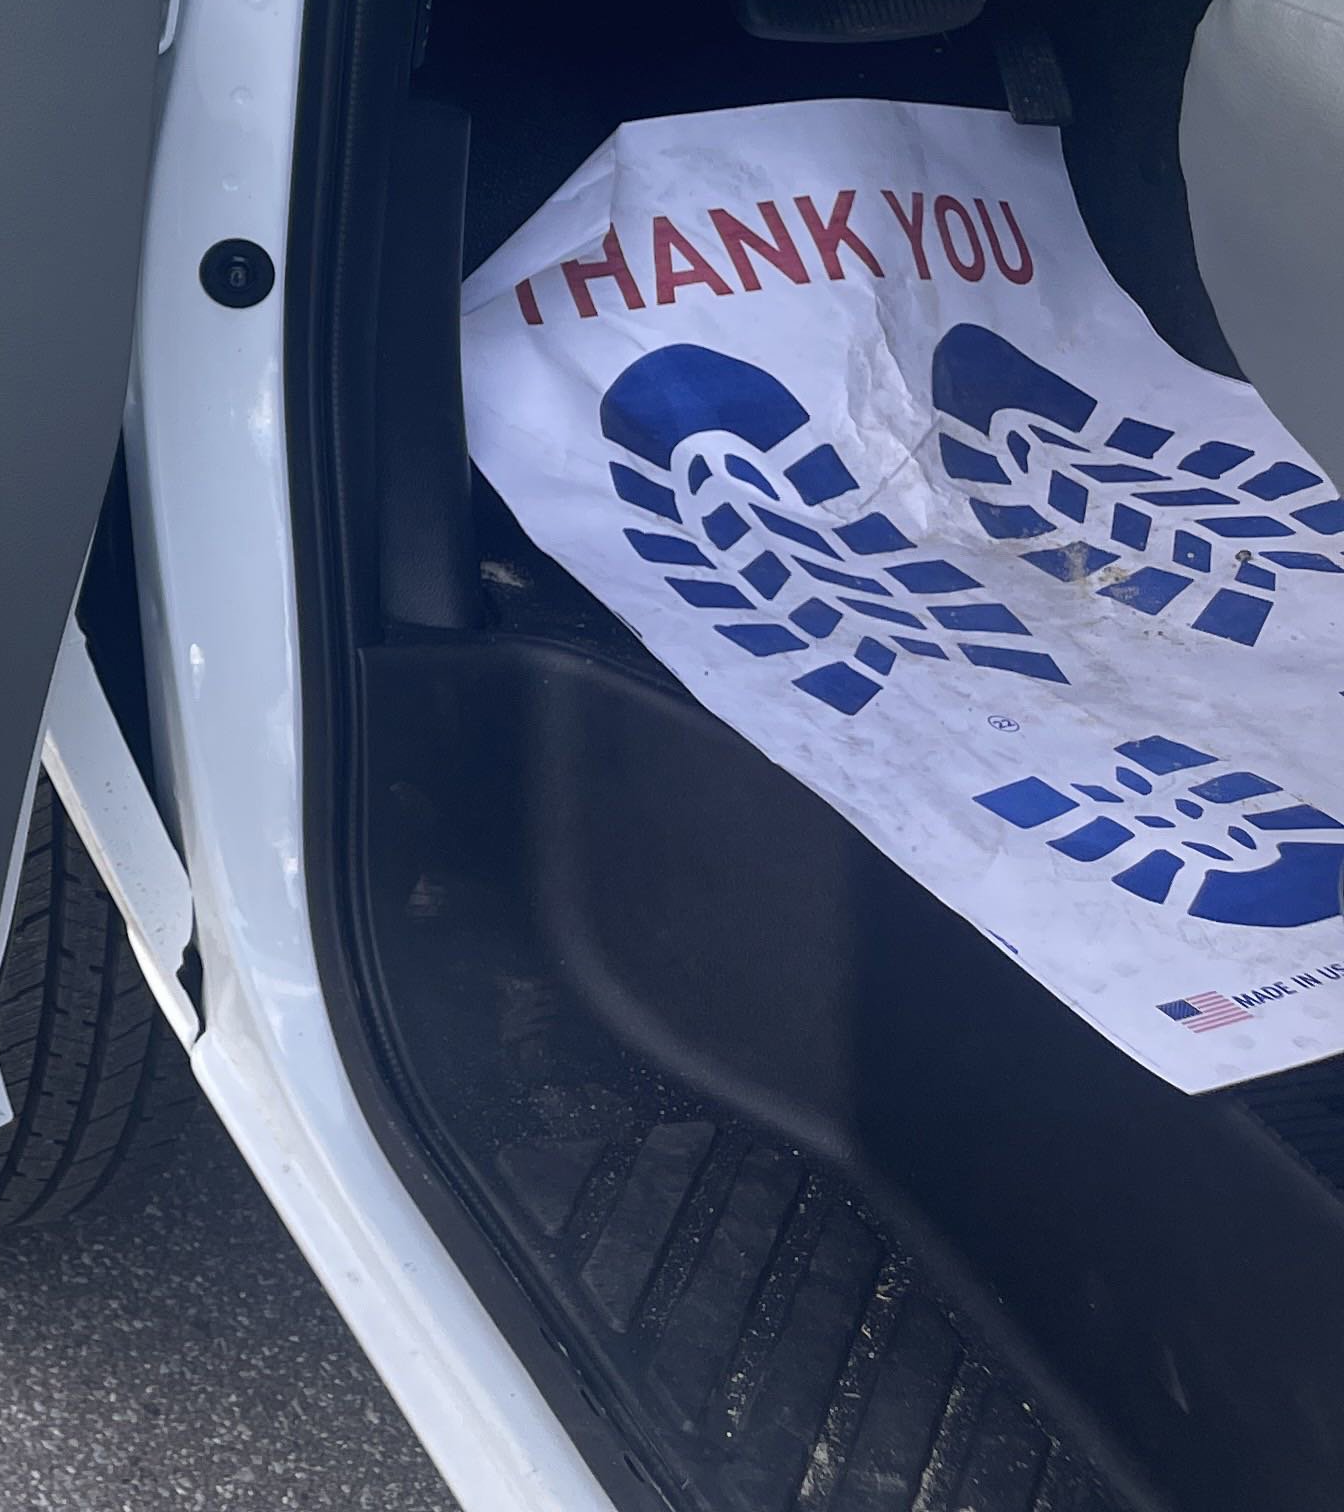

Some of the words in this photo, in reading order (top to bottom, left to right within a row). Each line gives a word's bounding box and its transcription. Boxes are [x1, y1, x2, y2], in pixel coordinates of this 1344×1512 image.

[881, 191, 1034, 286] YOU
[1231, 980, 1298, 1009] MADE
[1290, 972, 1323, 989] IN
[1316, 962, 1344, 981] US
